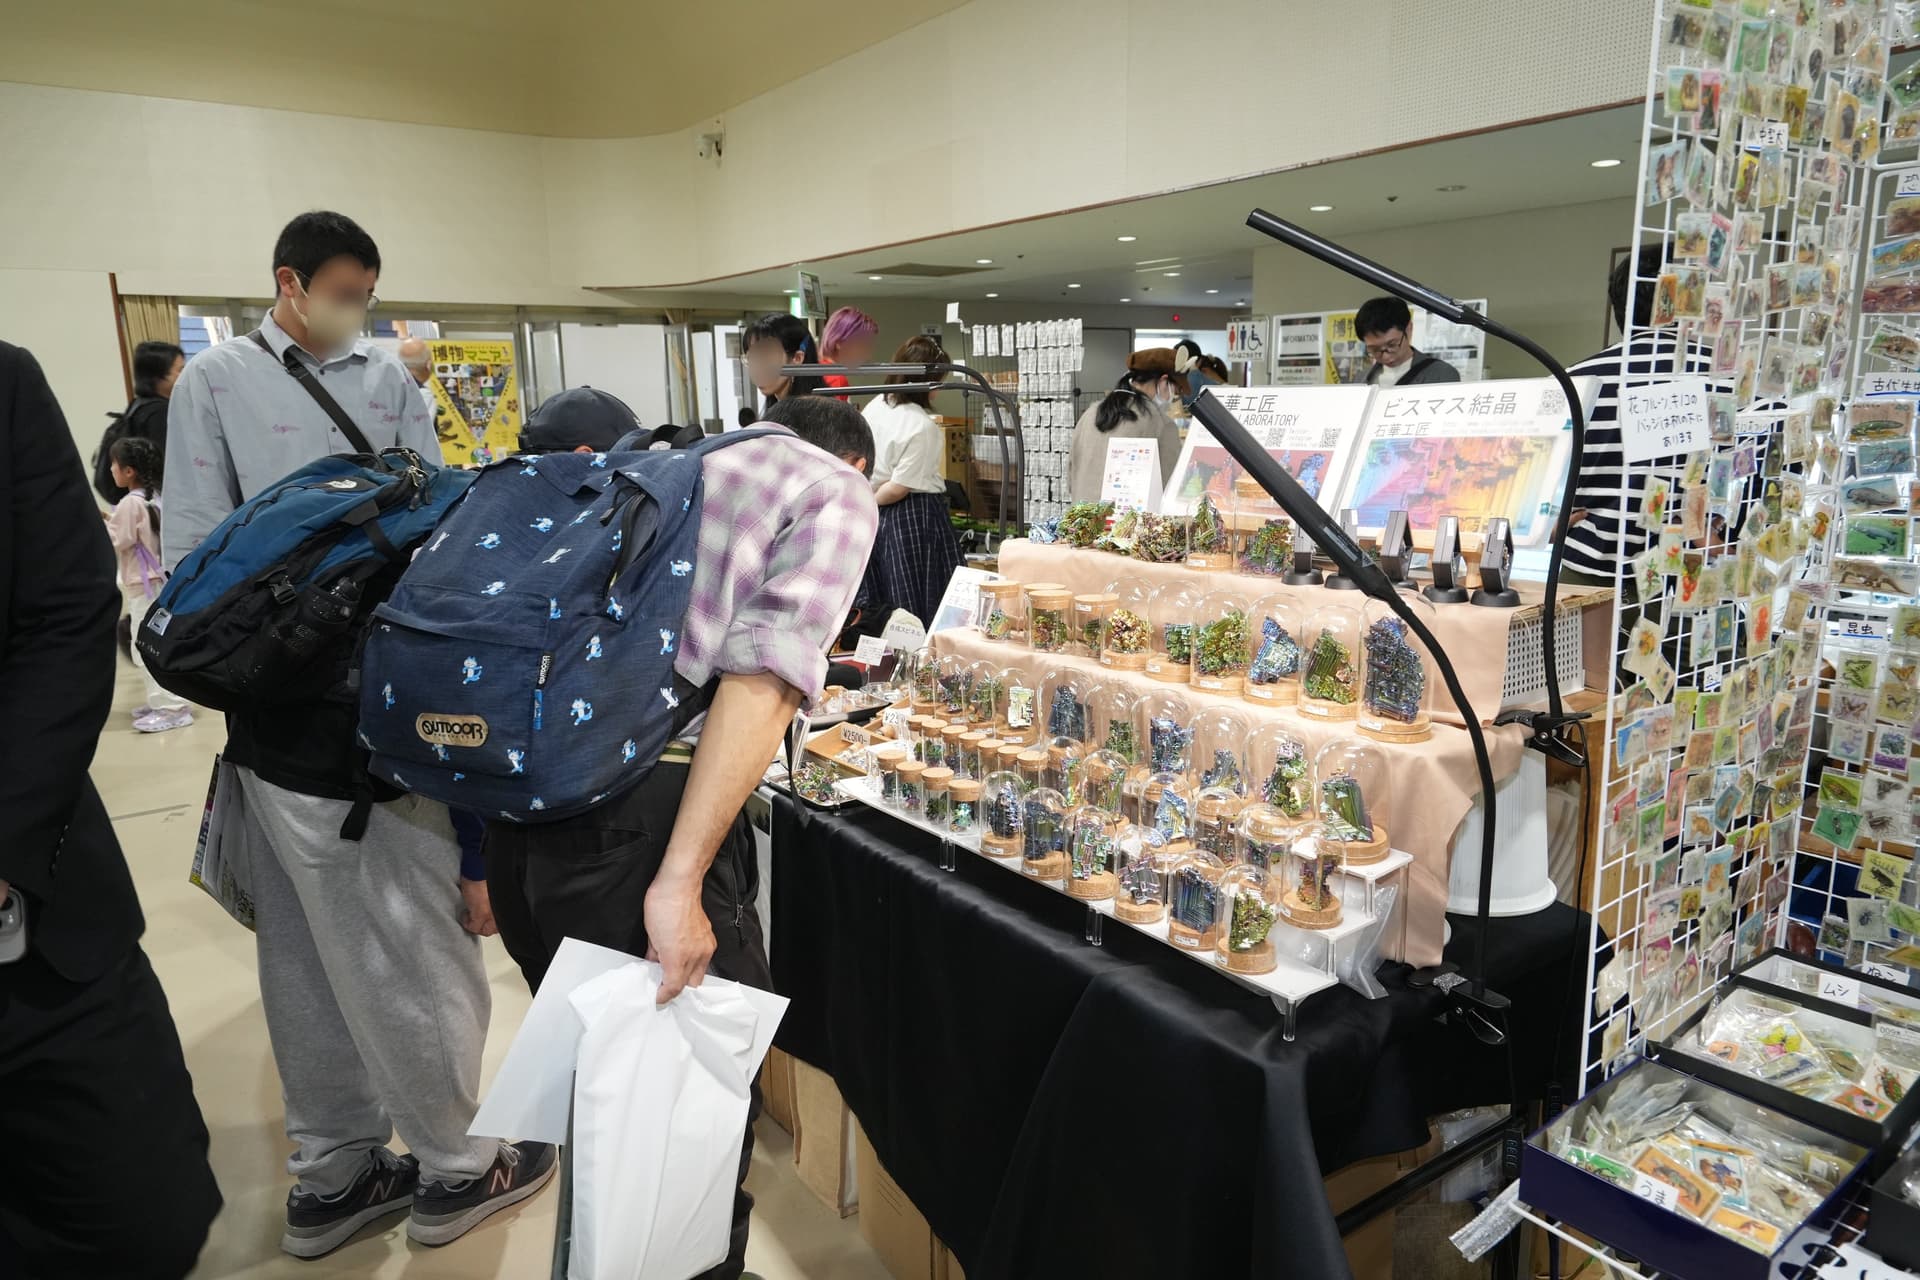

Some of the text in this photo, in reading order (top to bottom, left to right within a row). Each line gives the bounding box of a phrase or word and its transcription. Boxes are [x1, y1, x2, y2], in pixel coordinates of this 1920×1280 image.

[433, 344, 501, 362] 博物マニア
[1216, 394, 1278, 413] 華工匠
[1383, 391, 1517, 418] ビスマス結晶
[1238, 414, 1300, 426] LABORATORY
[1375, 421, 1432, 437] 石華工匠
[1847, 622, 1873, 635] 昆虫
[422, 720, 483, 739] OUTDOOR
[489, 1168, 513, 1194] N
[367, 1178, 397, 1205] N
